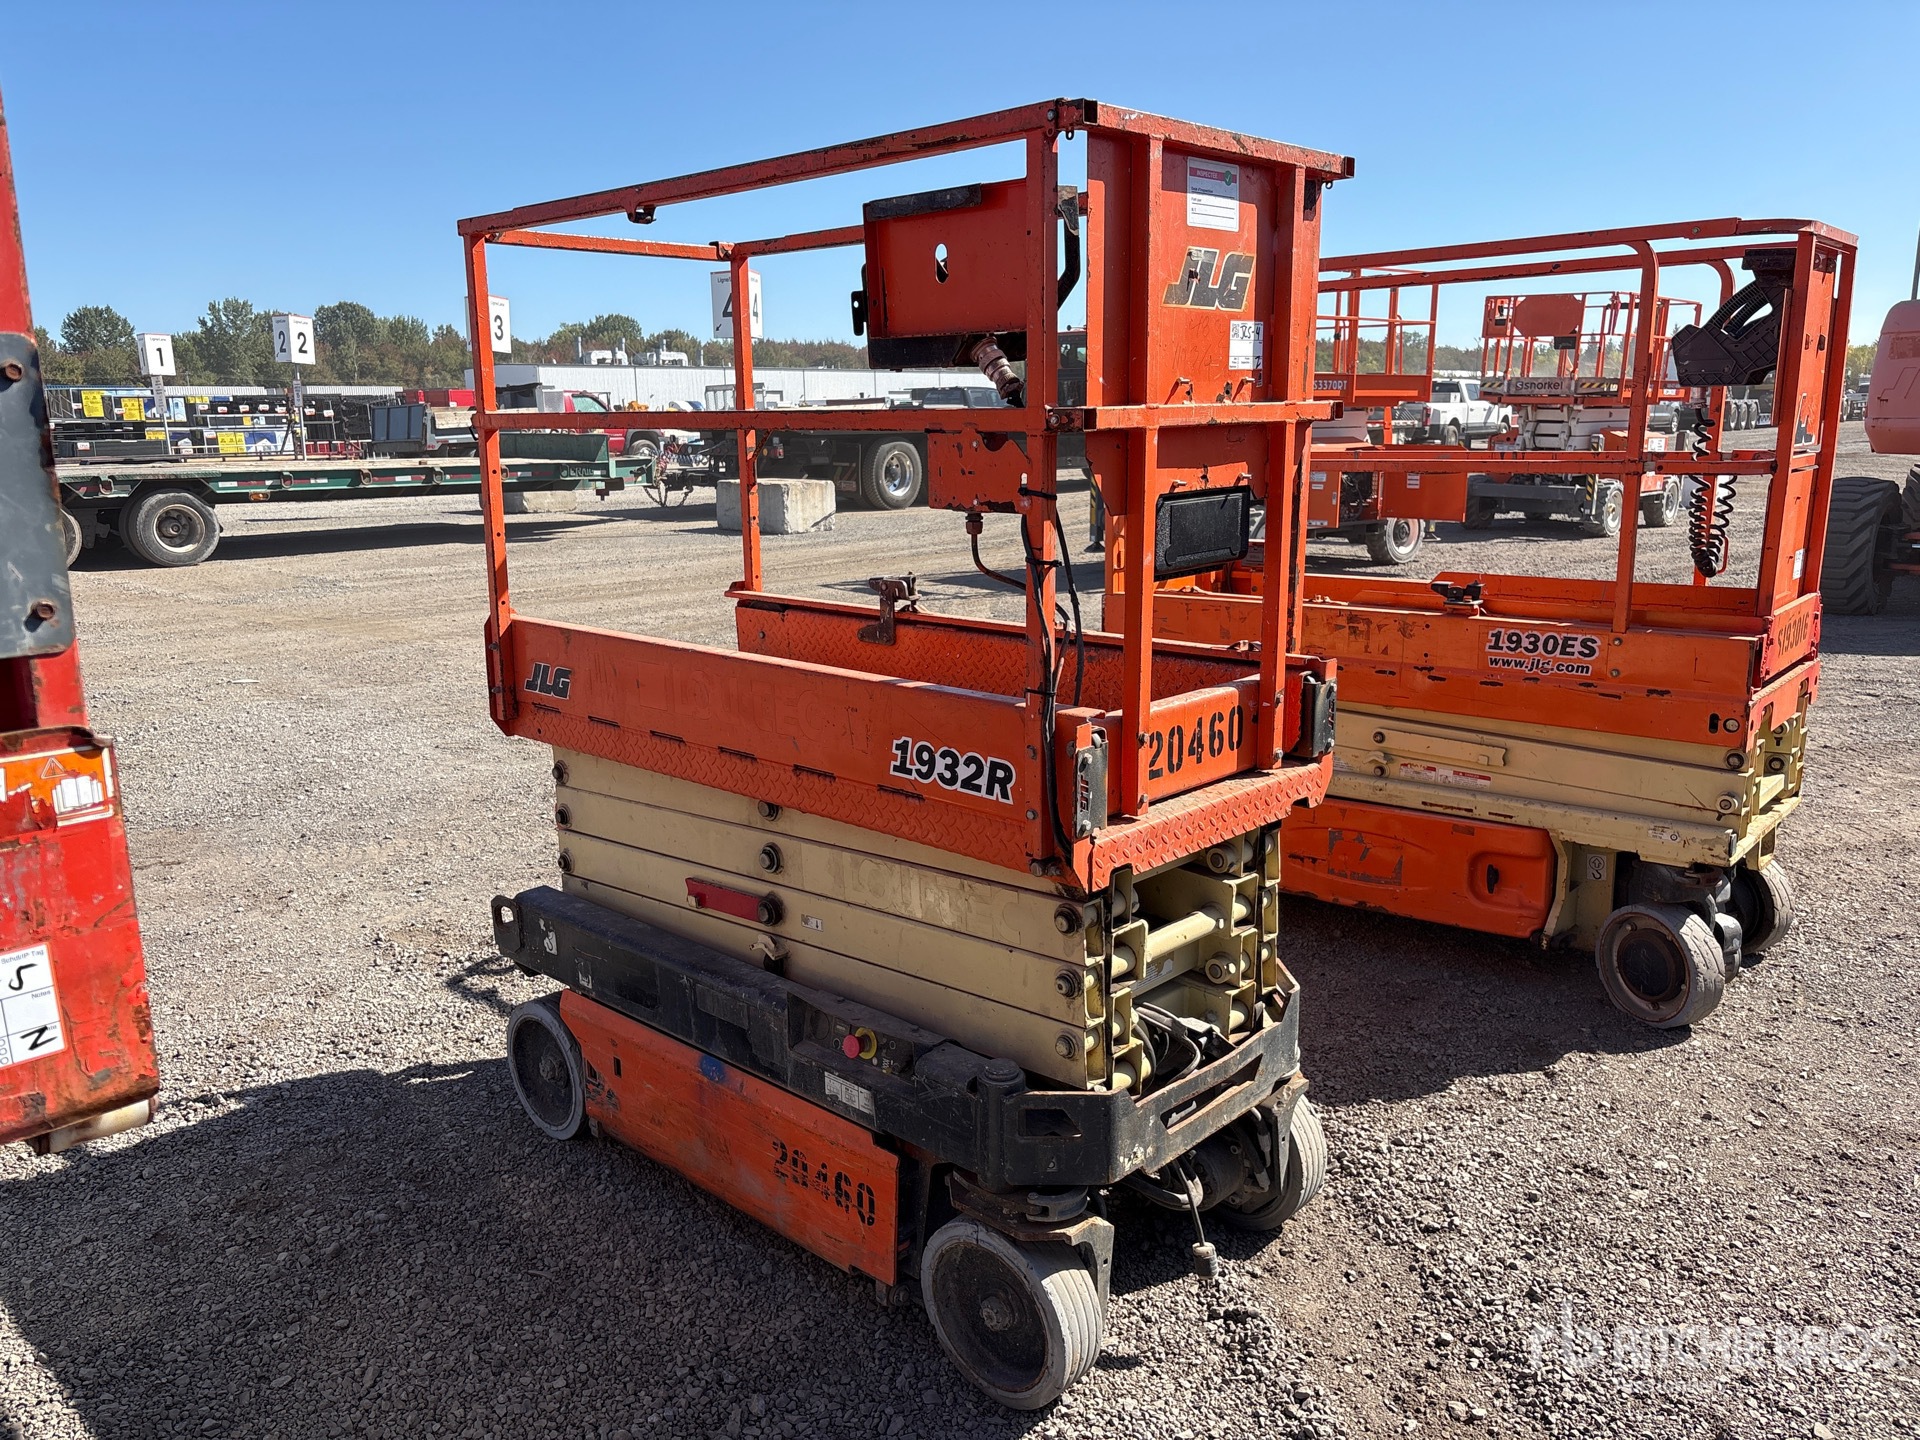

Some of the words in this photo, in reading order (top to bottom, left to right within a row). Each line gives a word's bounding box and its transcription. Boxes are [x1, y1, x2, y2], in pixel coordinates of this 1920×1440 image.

[1162, 246, 1256, 312] JLG
[494, 314, 504, 341] 3
[278, 330, 287, 353] 2
[297, 331, 308, 354] 2
[156, 347, 163, 367] 1
[1313, 380, 1348, 391] S3370RT
[1524, 380, 1563, 391] snorkel
[1486, 629, 1600, 659] 1930ES
[1488, 656, 1592, 675] www.jlg.com
[523, 661, 573, 700] JLG
[1147, 705, 1244, 781] 20460
[890, 737, 1016, 804] 1932R
